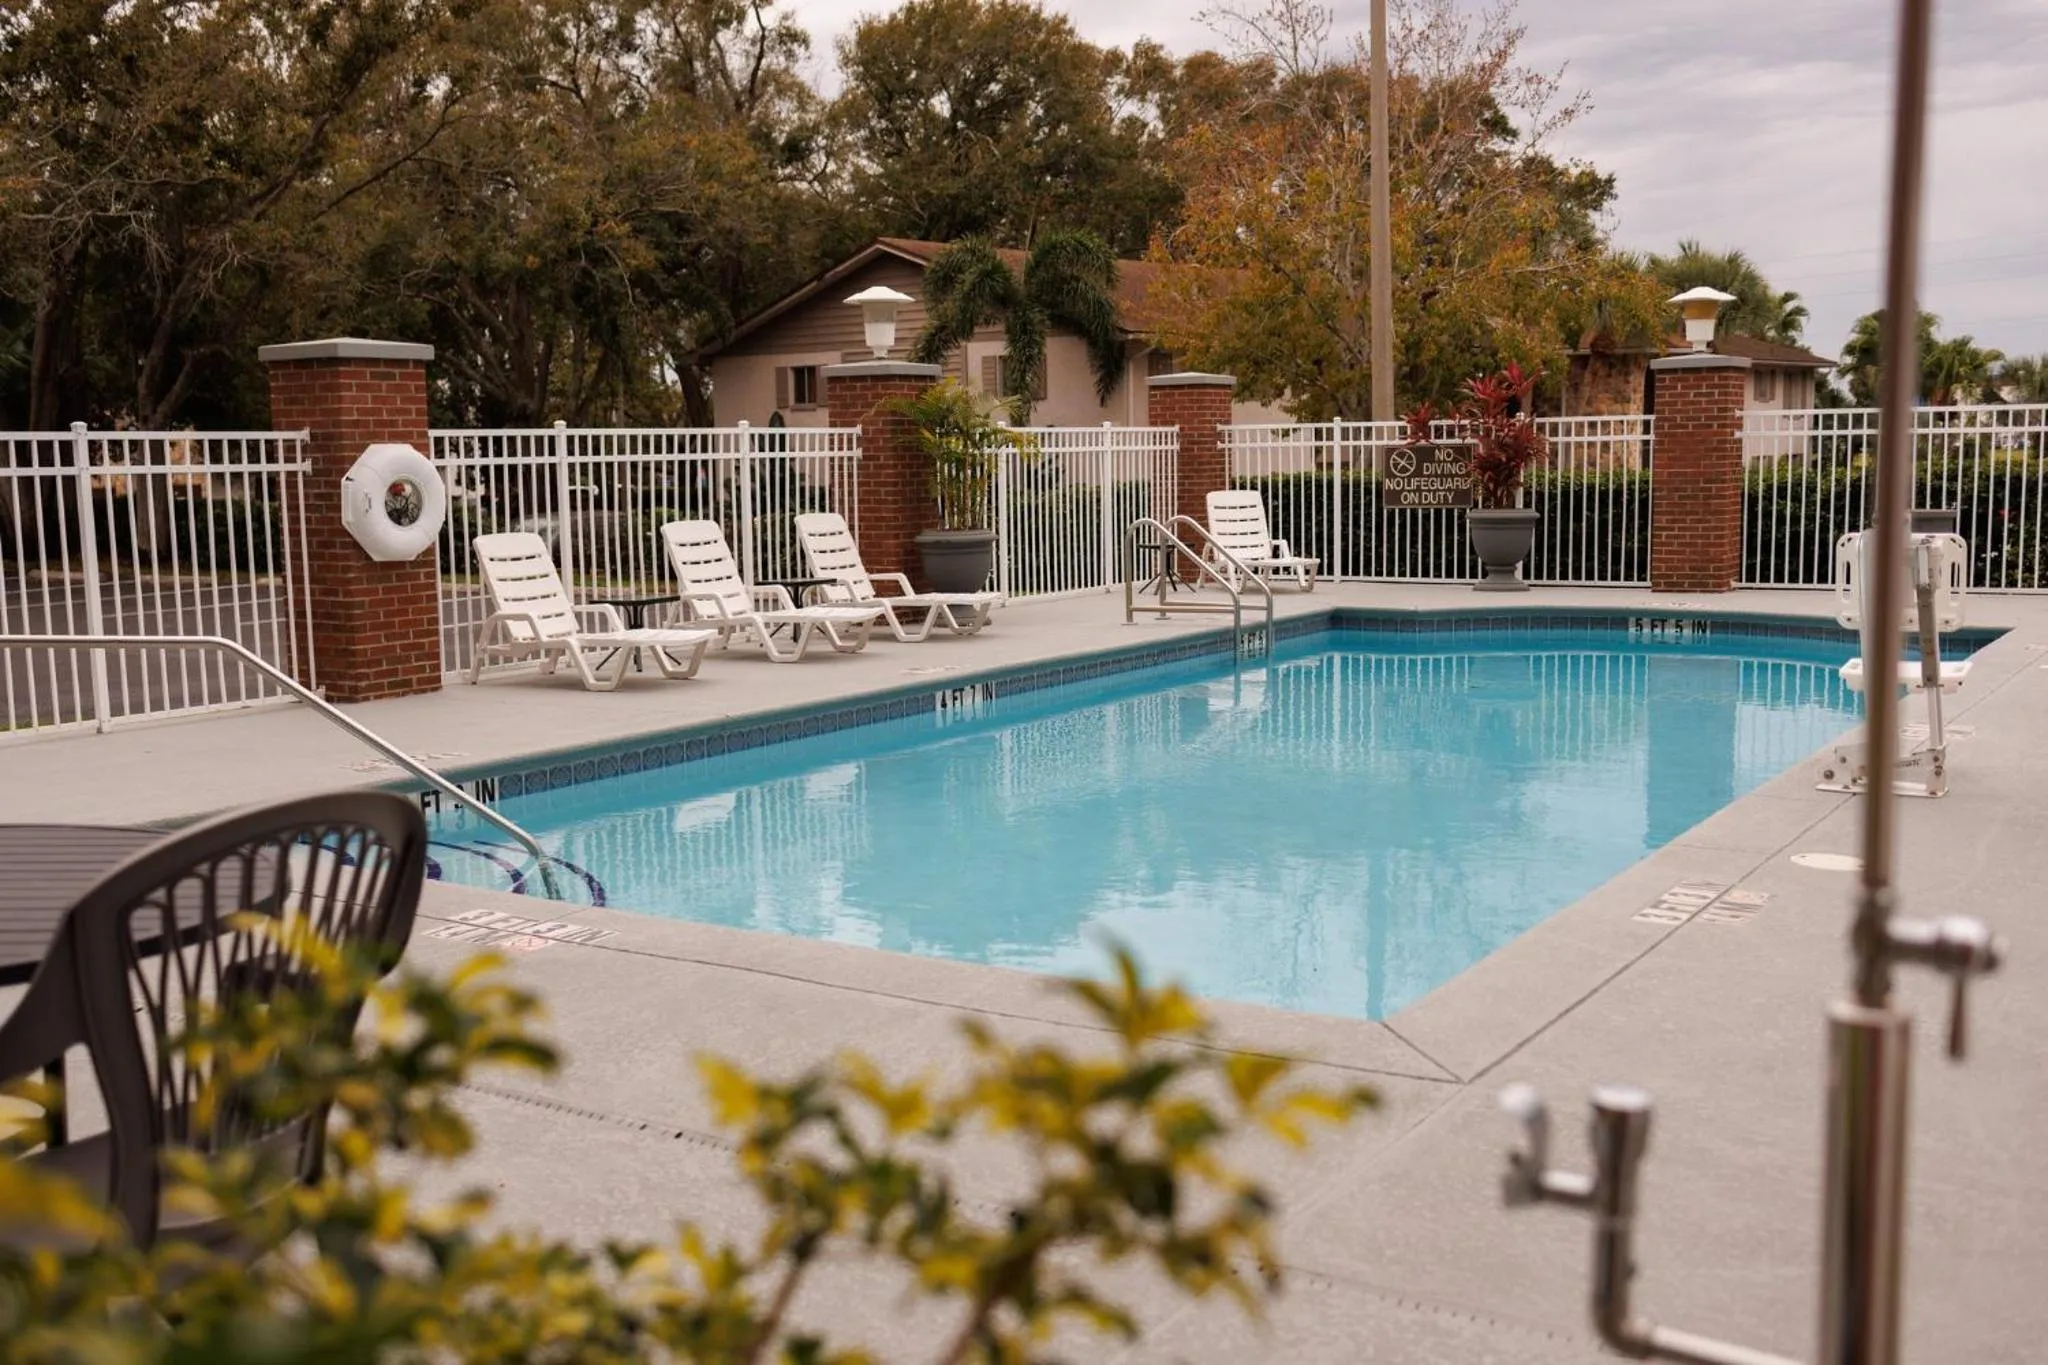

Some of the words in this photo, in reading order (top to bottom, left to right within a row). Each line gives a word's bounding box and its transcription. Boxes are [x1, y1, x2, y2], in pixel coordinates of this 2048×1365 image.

[1435, 448, 1454, 461] NO
[1423, 462, 1466, 475] DIVING
[1385, 478, 1403, 490] NO
[1404, 477, 1470, 490] LIFEGUARD
[1400, 491, 1419, 504] ON
[1422, 491, 1455, 504] DUTY
[1650, 618, 1667, 633] FT
[1691, 619, 1707, 634] IN
[952, 687, 964, 707] FT
[982, 681, 993, 702] IN
[420, 789, 442, 812] FT
[475, 777, 496, 804] IN
